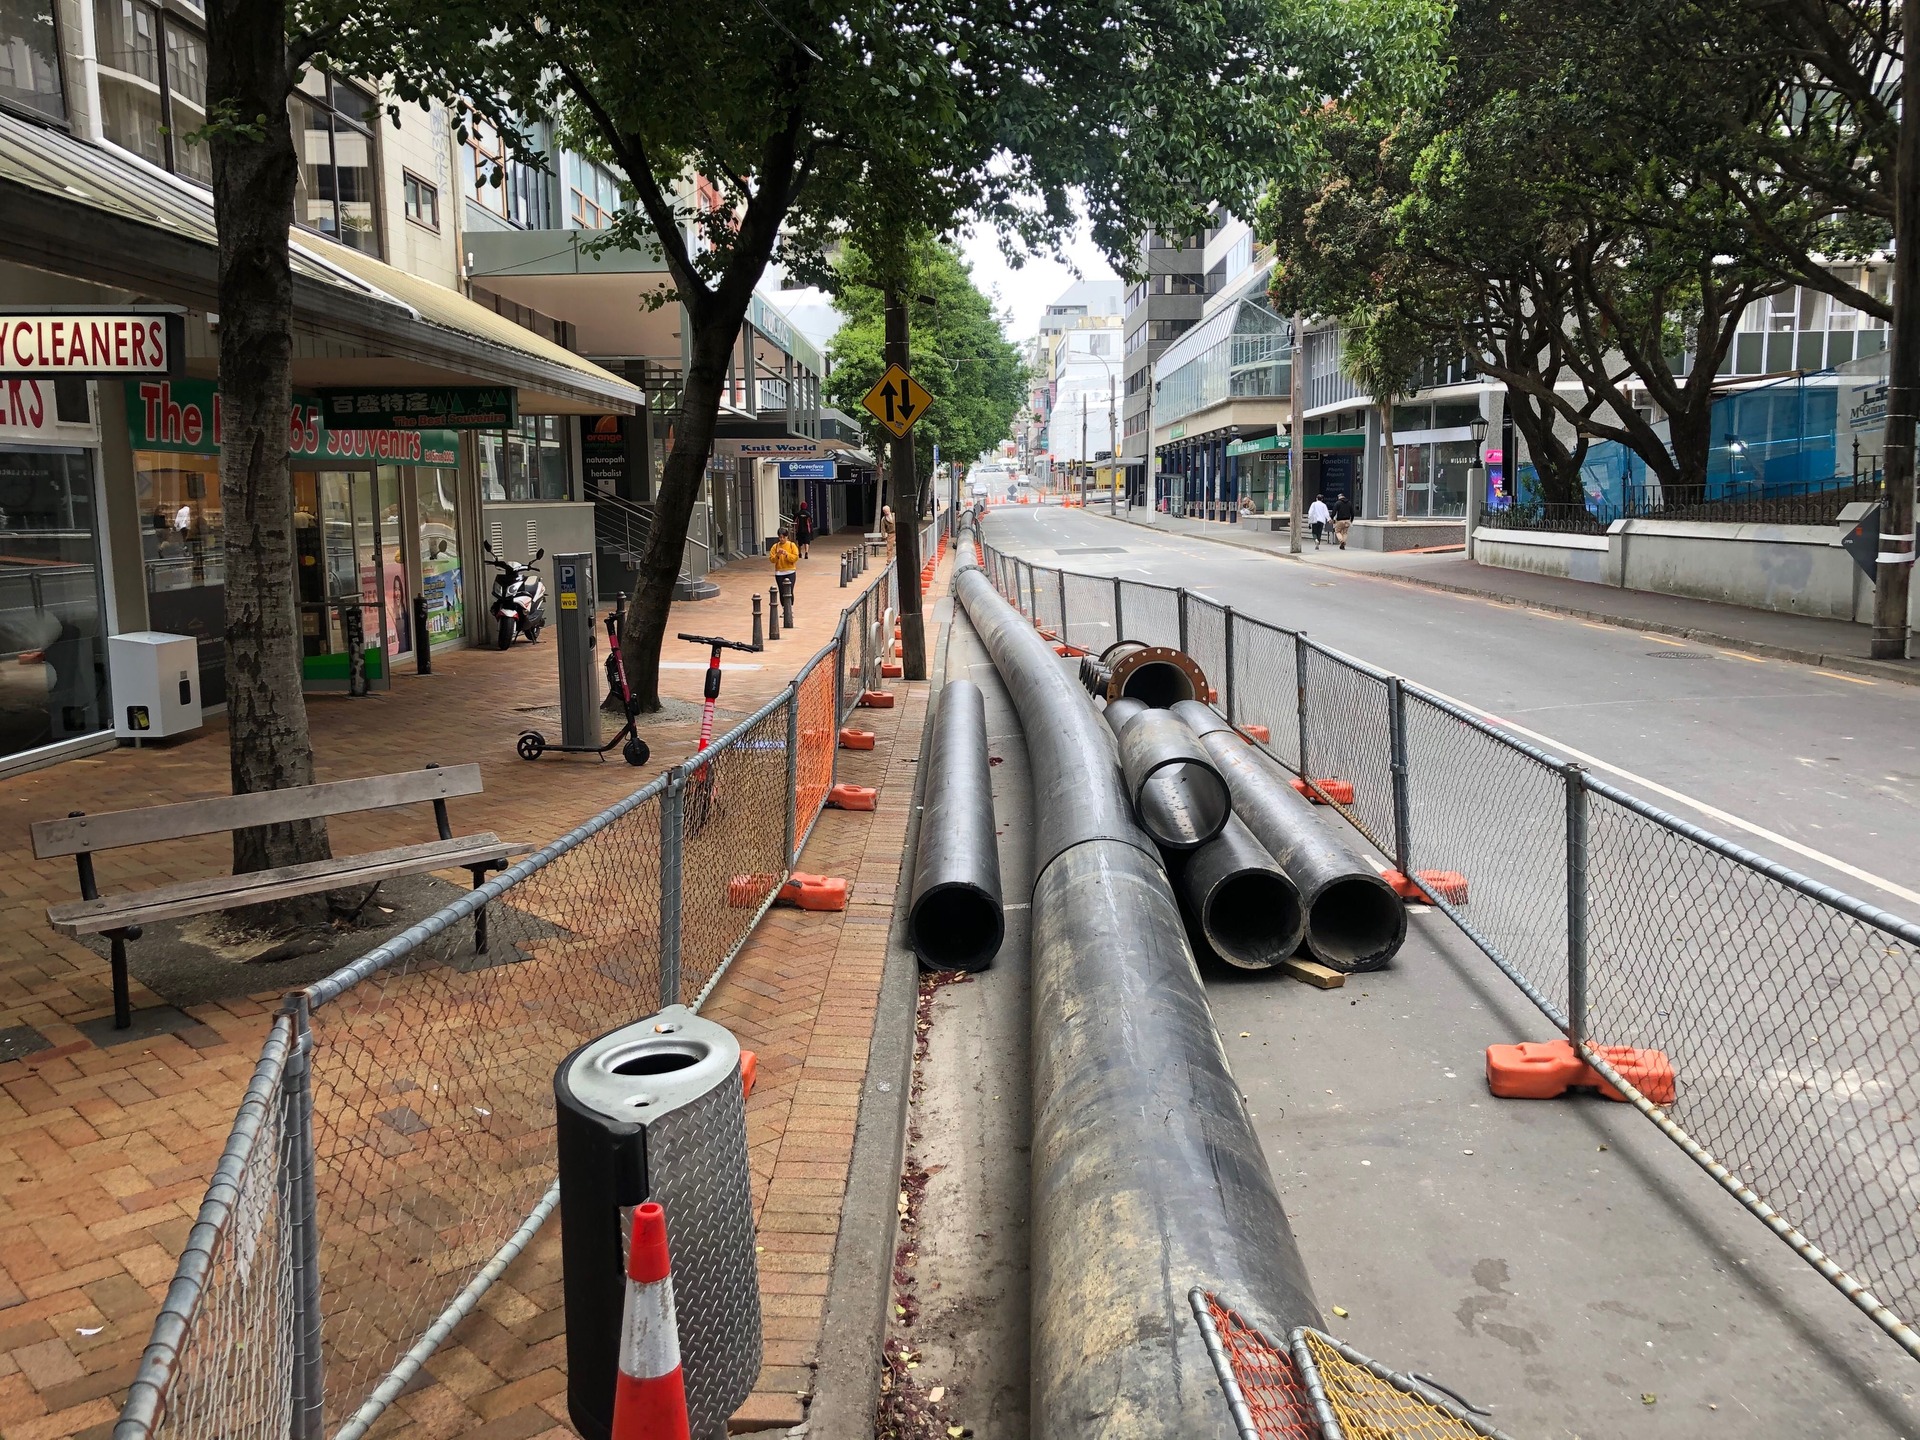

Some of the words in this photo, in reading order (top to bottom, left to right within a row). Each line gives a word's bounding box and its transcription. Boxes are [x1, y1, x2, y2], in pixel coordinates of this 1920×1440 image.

[140, 380, 203, 446] The
[393, 415, 416, 428] The
[418, 414, 446, 426] Best
[449, 412, 507, 425] Souvenirs
[586, 433, 622, 444] orange
[740, 444, 772, 452] Knit
[775, 444, 817, 452] World
[586, 455, 625, 465] naturopath
[591, 469, 622, 477] herbalist
[561, 566, 574, 583] P
